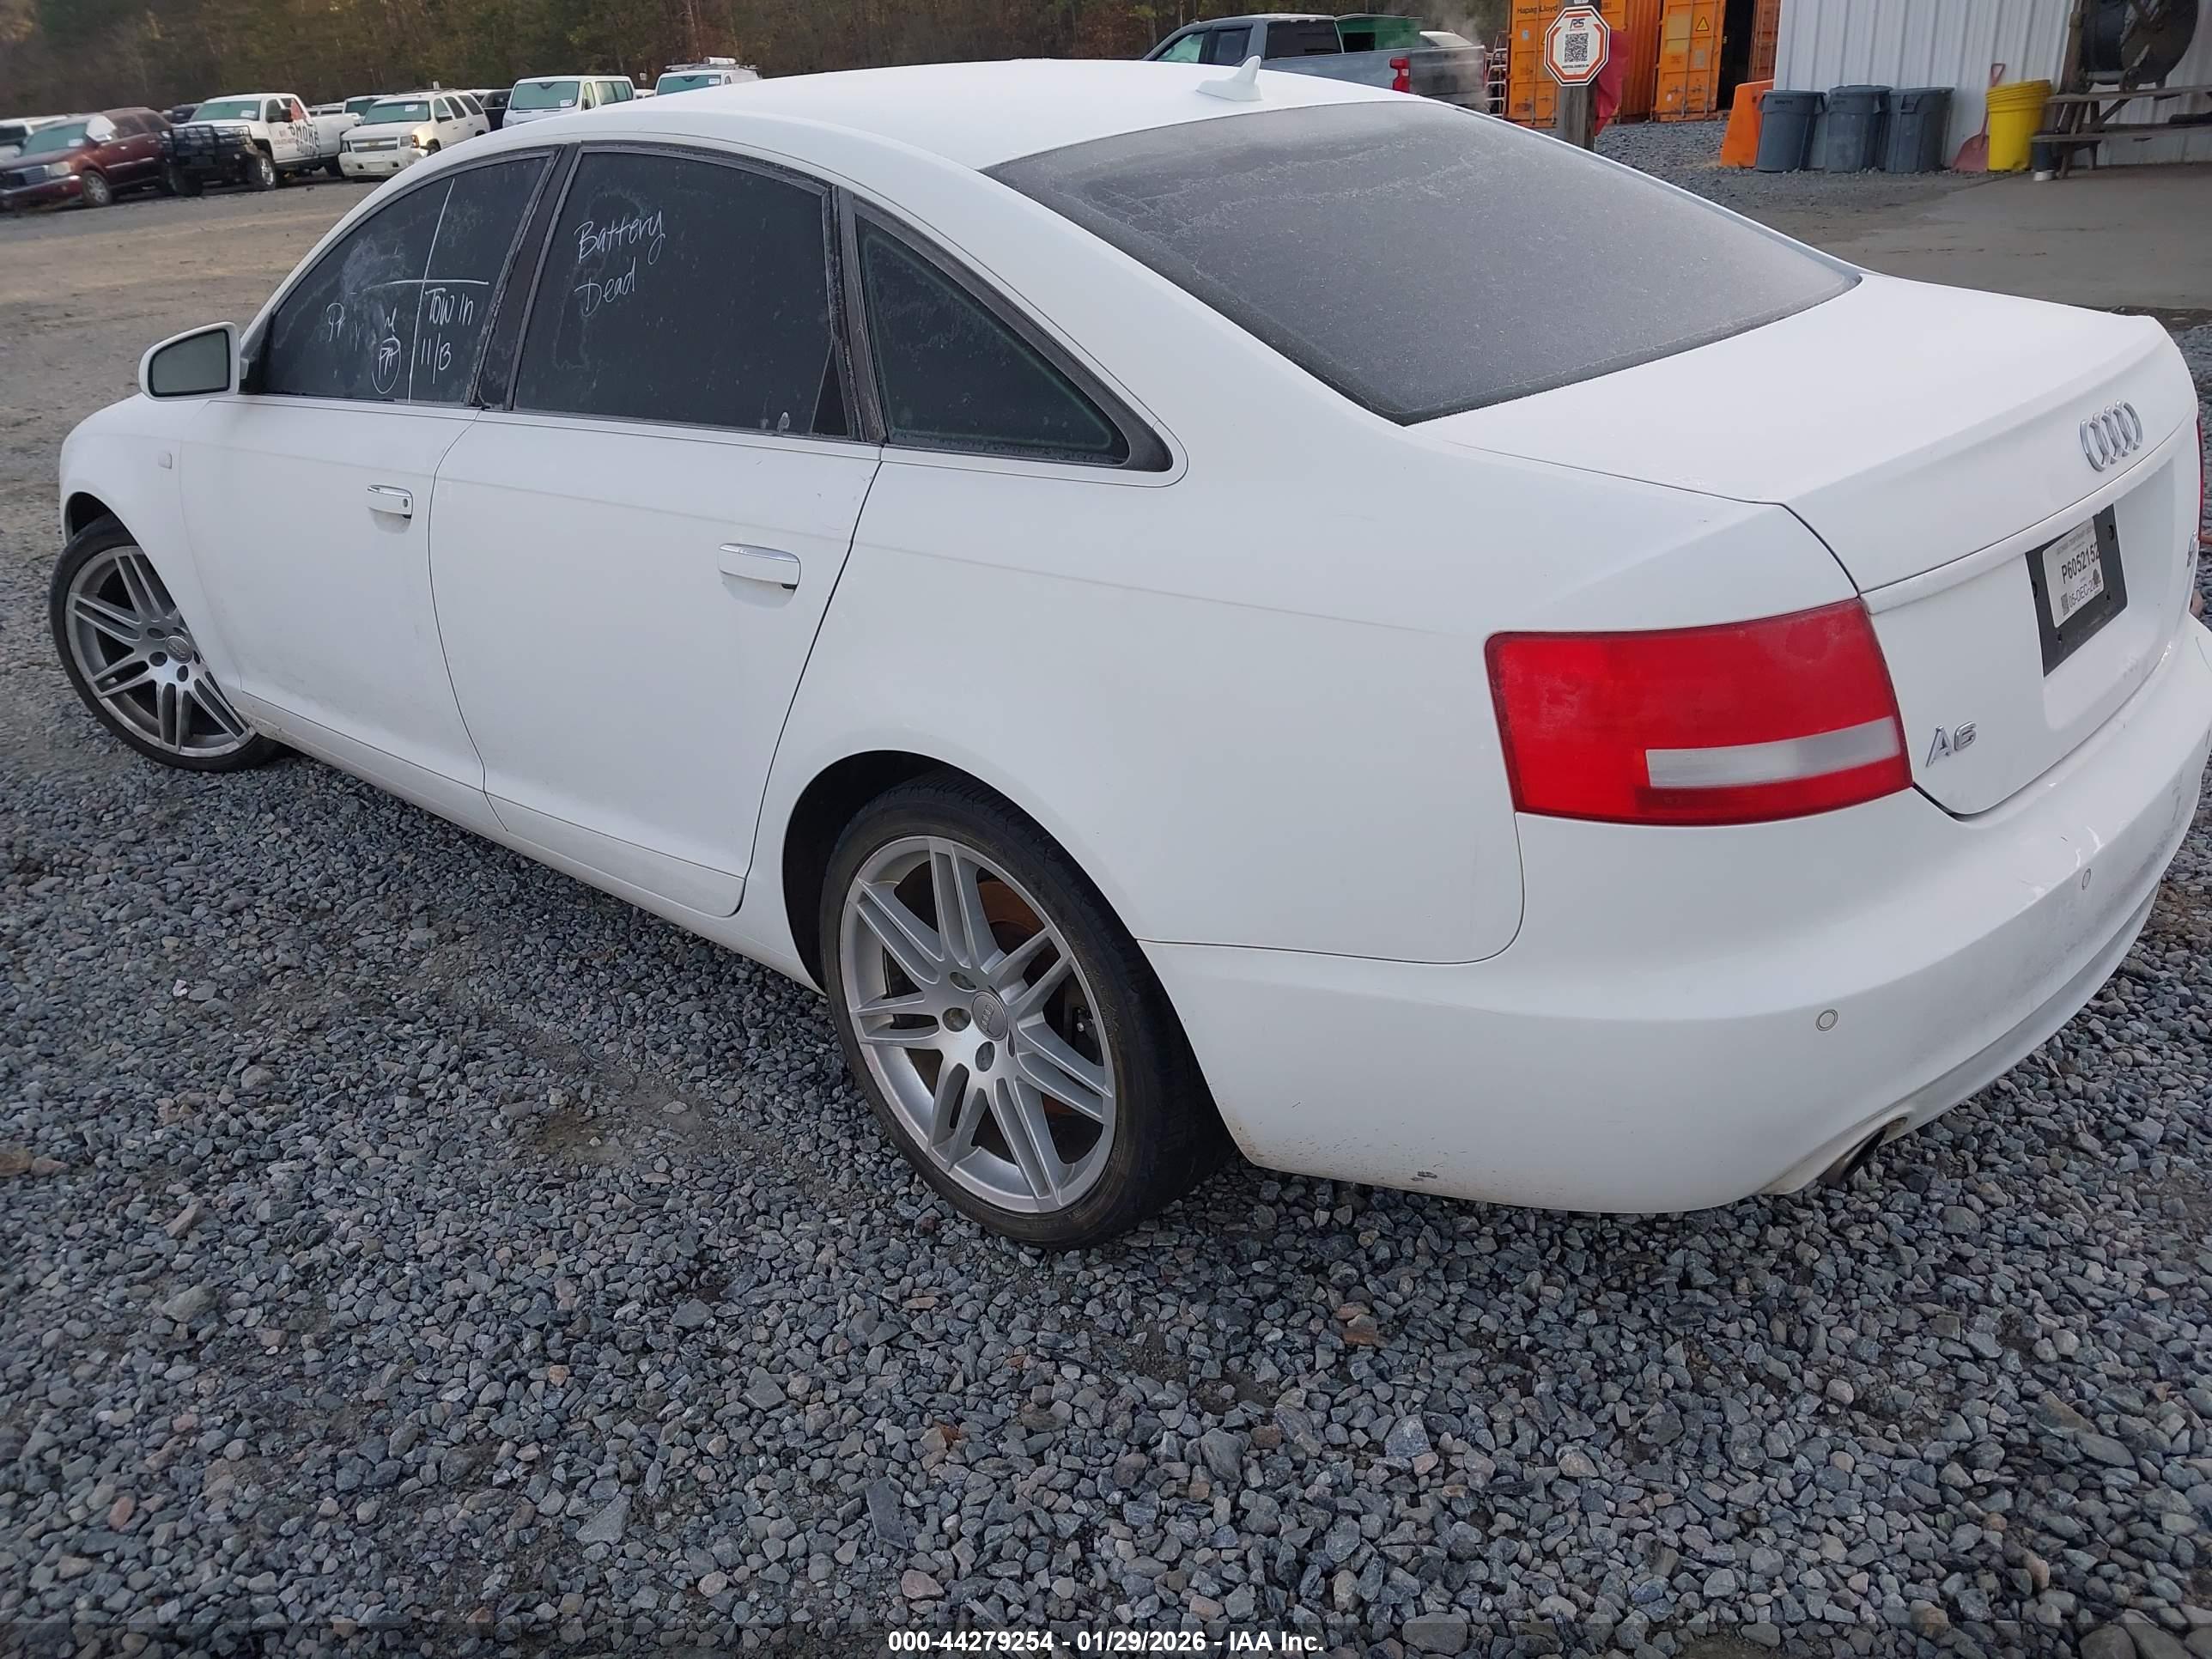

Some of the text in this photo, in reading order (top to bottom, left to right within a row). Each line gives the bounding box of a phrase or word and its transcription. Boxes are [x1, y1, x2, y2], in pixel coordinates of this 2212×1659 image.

[574, 210, 665, 264] Battery
[574, 257, 636, 317] Dead
[1926, 722, 1977, 768] A6
